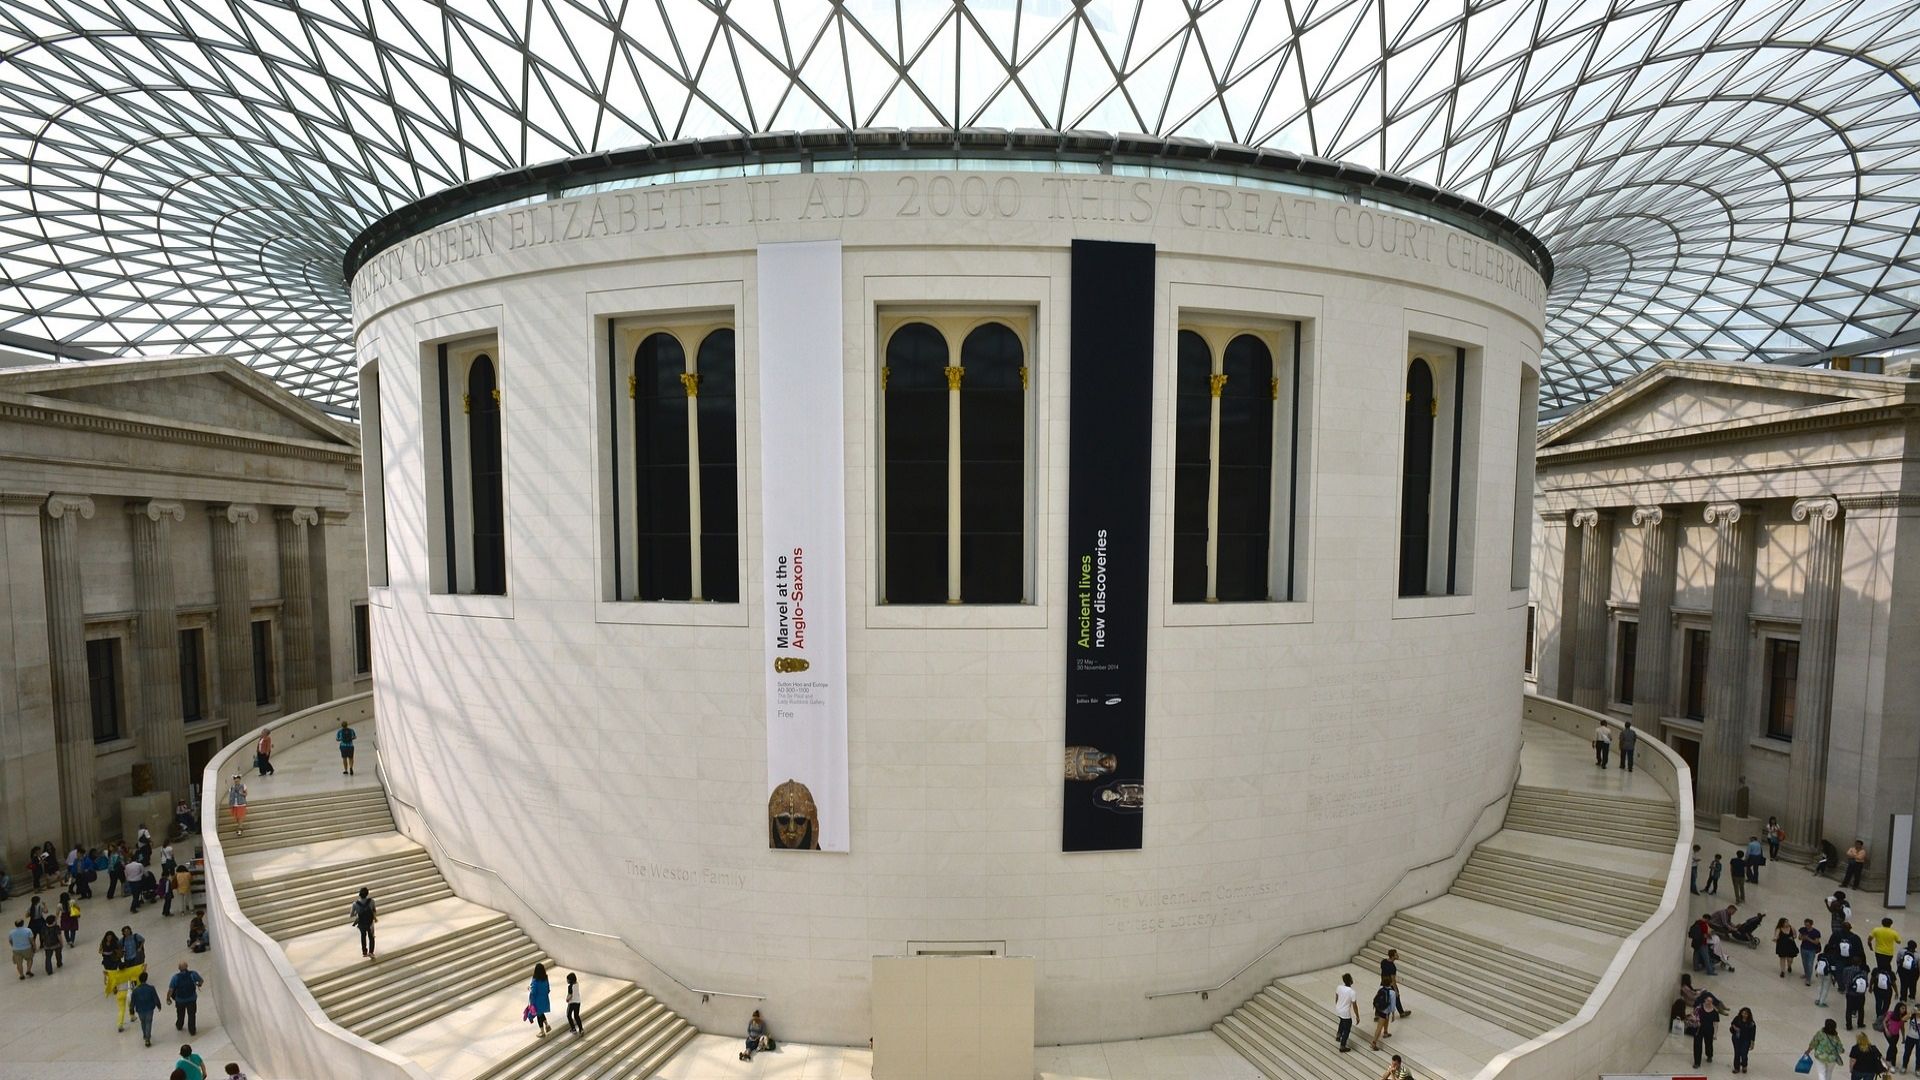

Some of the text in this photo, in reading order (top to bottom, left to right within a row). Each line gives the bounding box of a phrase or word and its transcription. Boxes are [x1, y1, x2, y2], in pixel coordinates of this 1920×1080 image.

[414, 216, 496, 276] QUEEN
[508, 184, 729, 250] ELIZABETH
[798, 177, 870, 219] AD
[896, 175, 1021, 217] 2000
[1042, 178, 1153, 223] THIS
[1177, 186, 1317, 240] GREAT
[1333, 206, 1436, 262] COURT
[776, 555, 789, 649] Marvel at the
[792, 547, 806, 649] Anglo-Saxons
[1078, 555, 1092, 649] Ancient lives
[1094, 529, 1107, 648] new discoveries
[777, 709, 794, 718] Free
[625, 859, 746, 889] The Weston Family
